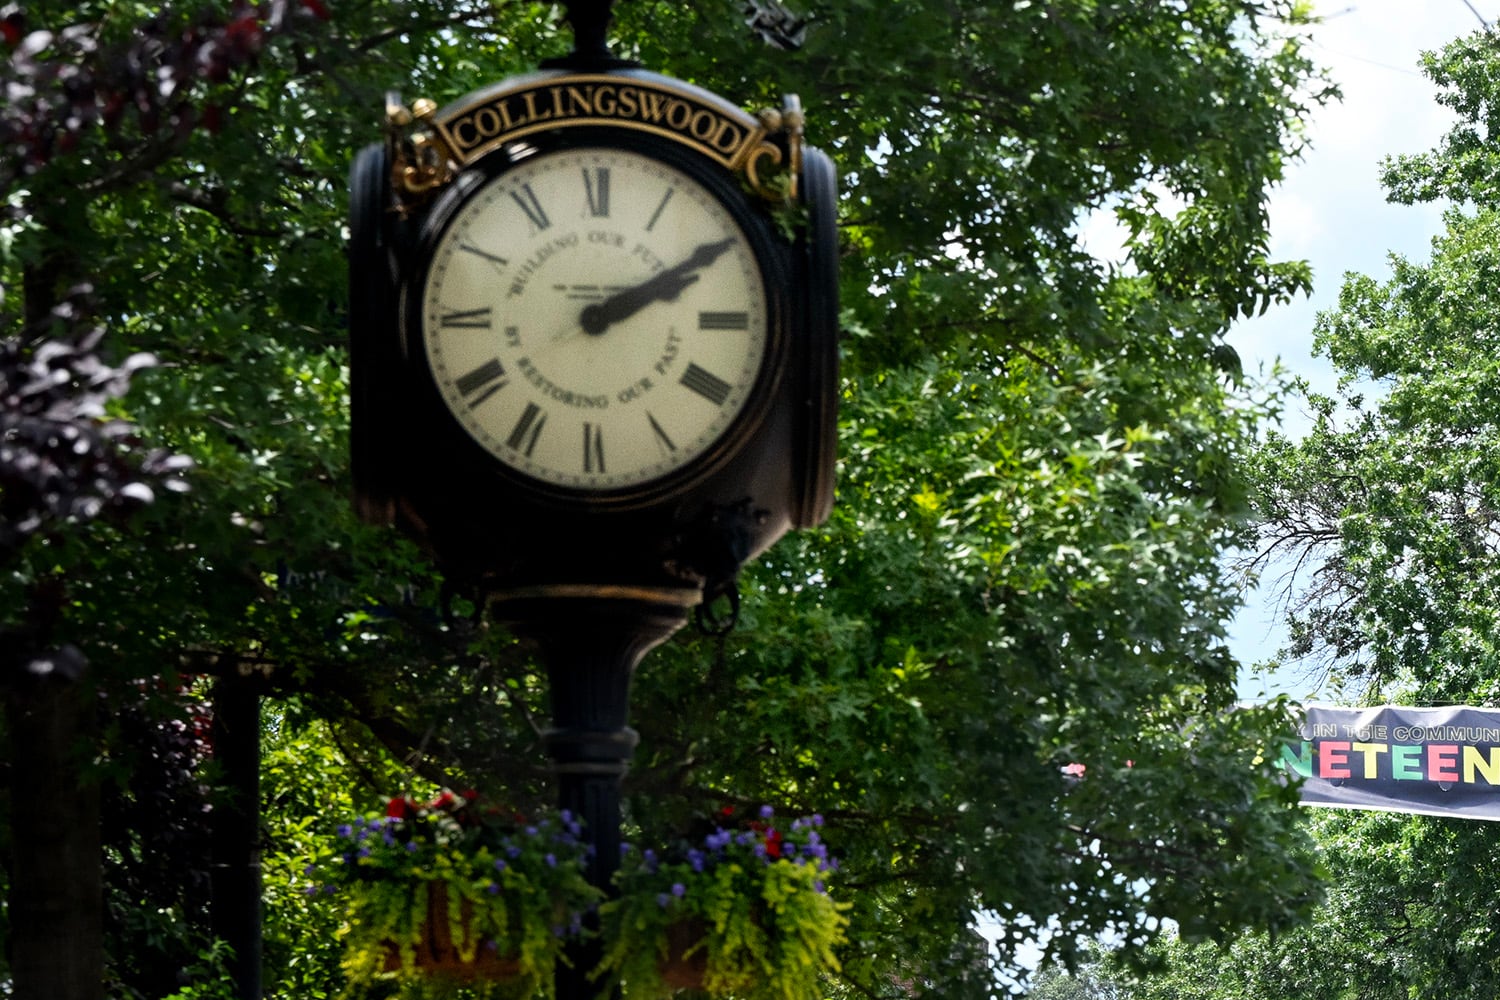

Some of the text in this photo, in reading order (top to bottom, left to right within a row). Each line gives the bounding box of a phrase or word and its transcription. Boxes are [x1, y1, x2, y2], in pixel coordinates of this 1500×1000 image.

[452, 85, 742, 157] COLLINGSWOOD
[1313, 724, 1337, 738] IN
[1343, 724, 1388, 741] THE
